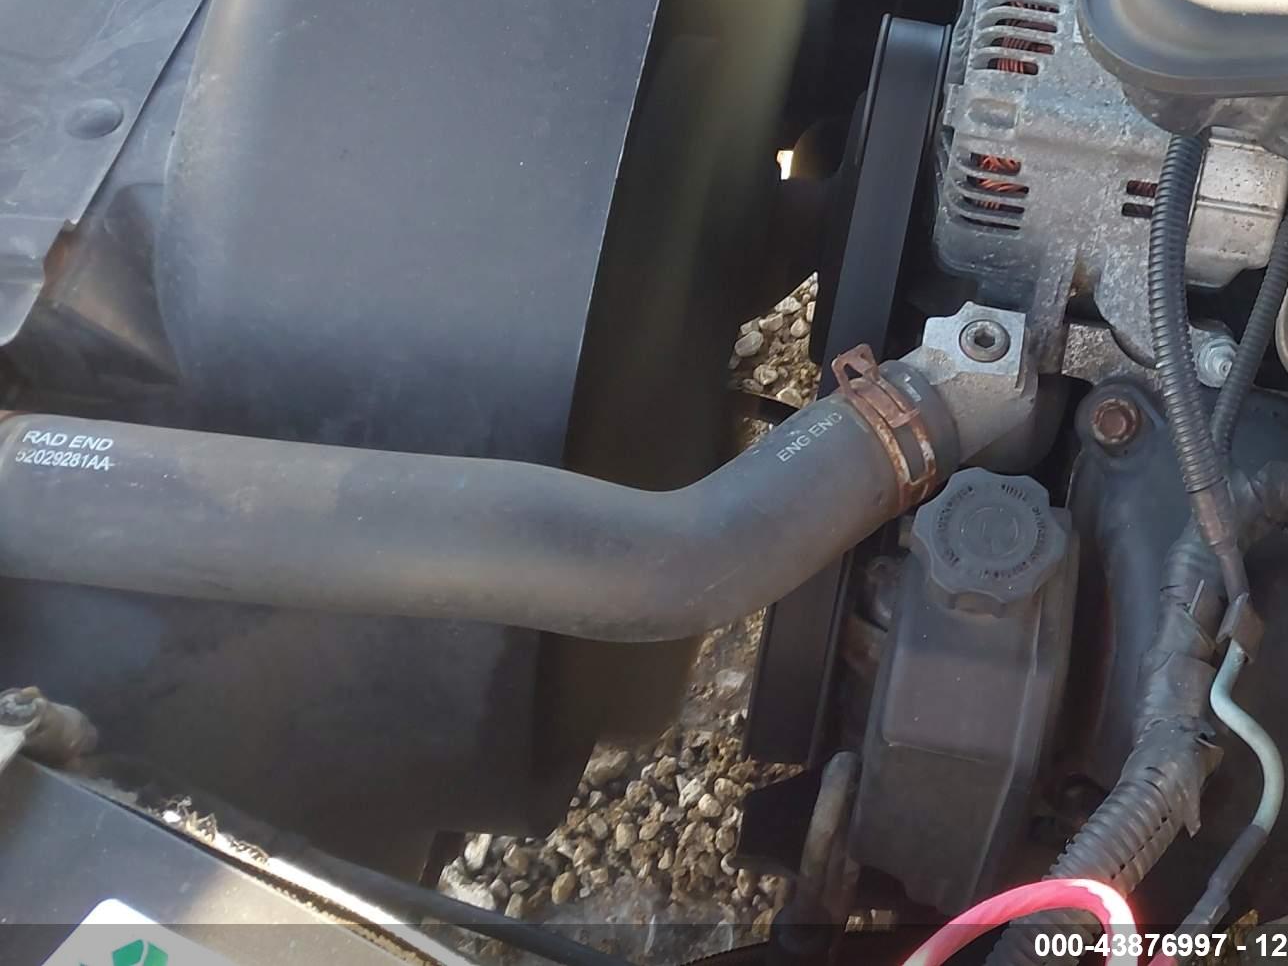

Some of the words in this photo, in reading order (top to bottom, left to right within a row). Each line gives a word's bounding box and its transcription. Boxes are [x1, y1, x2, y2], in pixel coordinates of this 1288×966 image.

[22, 430, 67, 446] RAD
[68, 435, 115, 451] END
[776, 434, 811, 462] ENG
[808, 412, 843, 438] END
